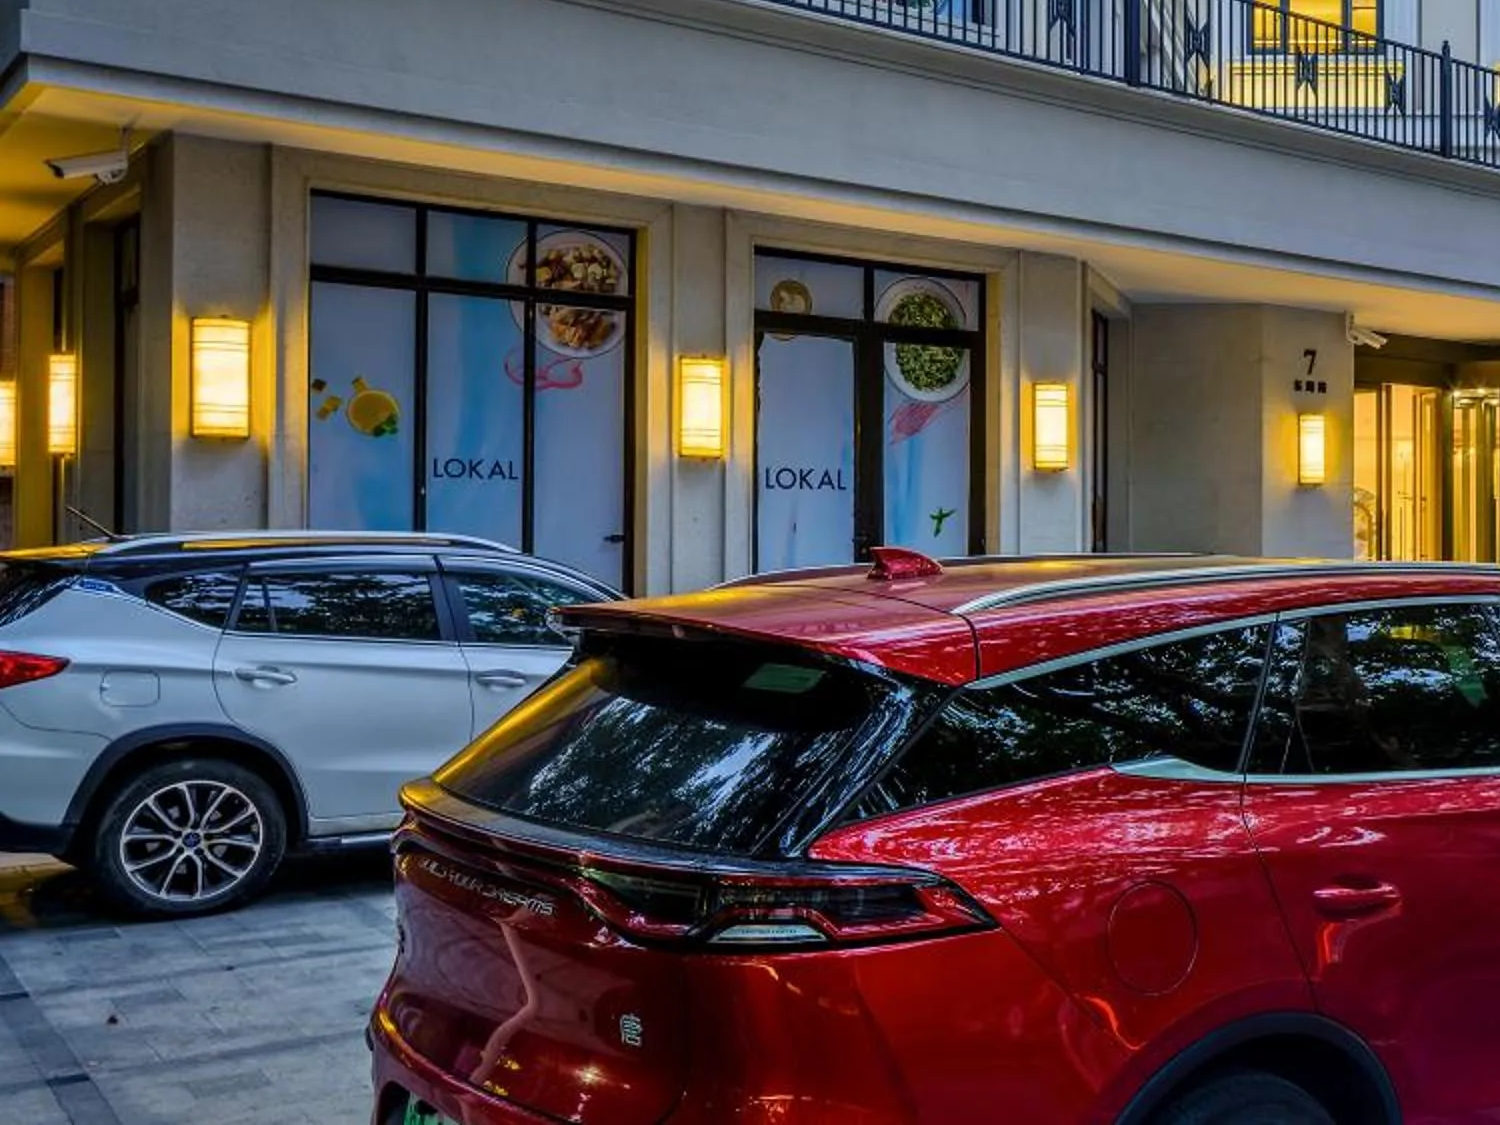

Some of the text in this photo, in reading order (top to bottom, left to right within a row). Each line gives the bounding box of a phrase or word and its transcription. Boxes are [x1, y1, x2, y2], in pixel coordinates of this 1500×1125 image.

[1303, 348, 1317, 376] 7
[433, 458, 520, 480] LOKAL
[765, 466, 847, 490] LOKAL
